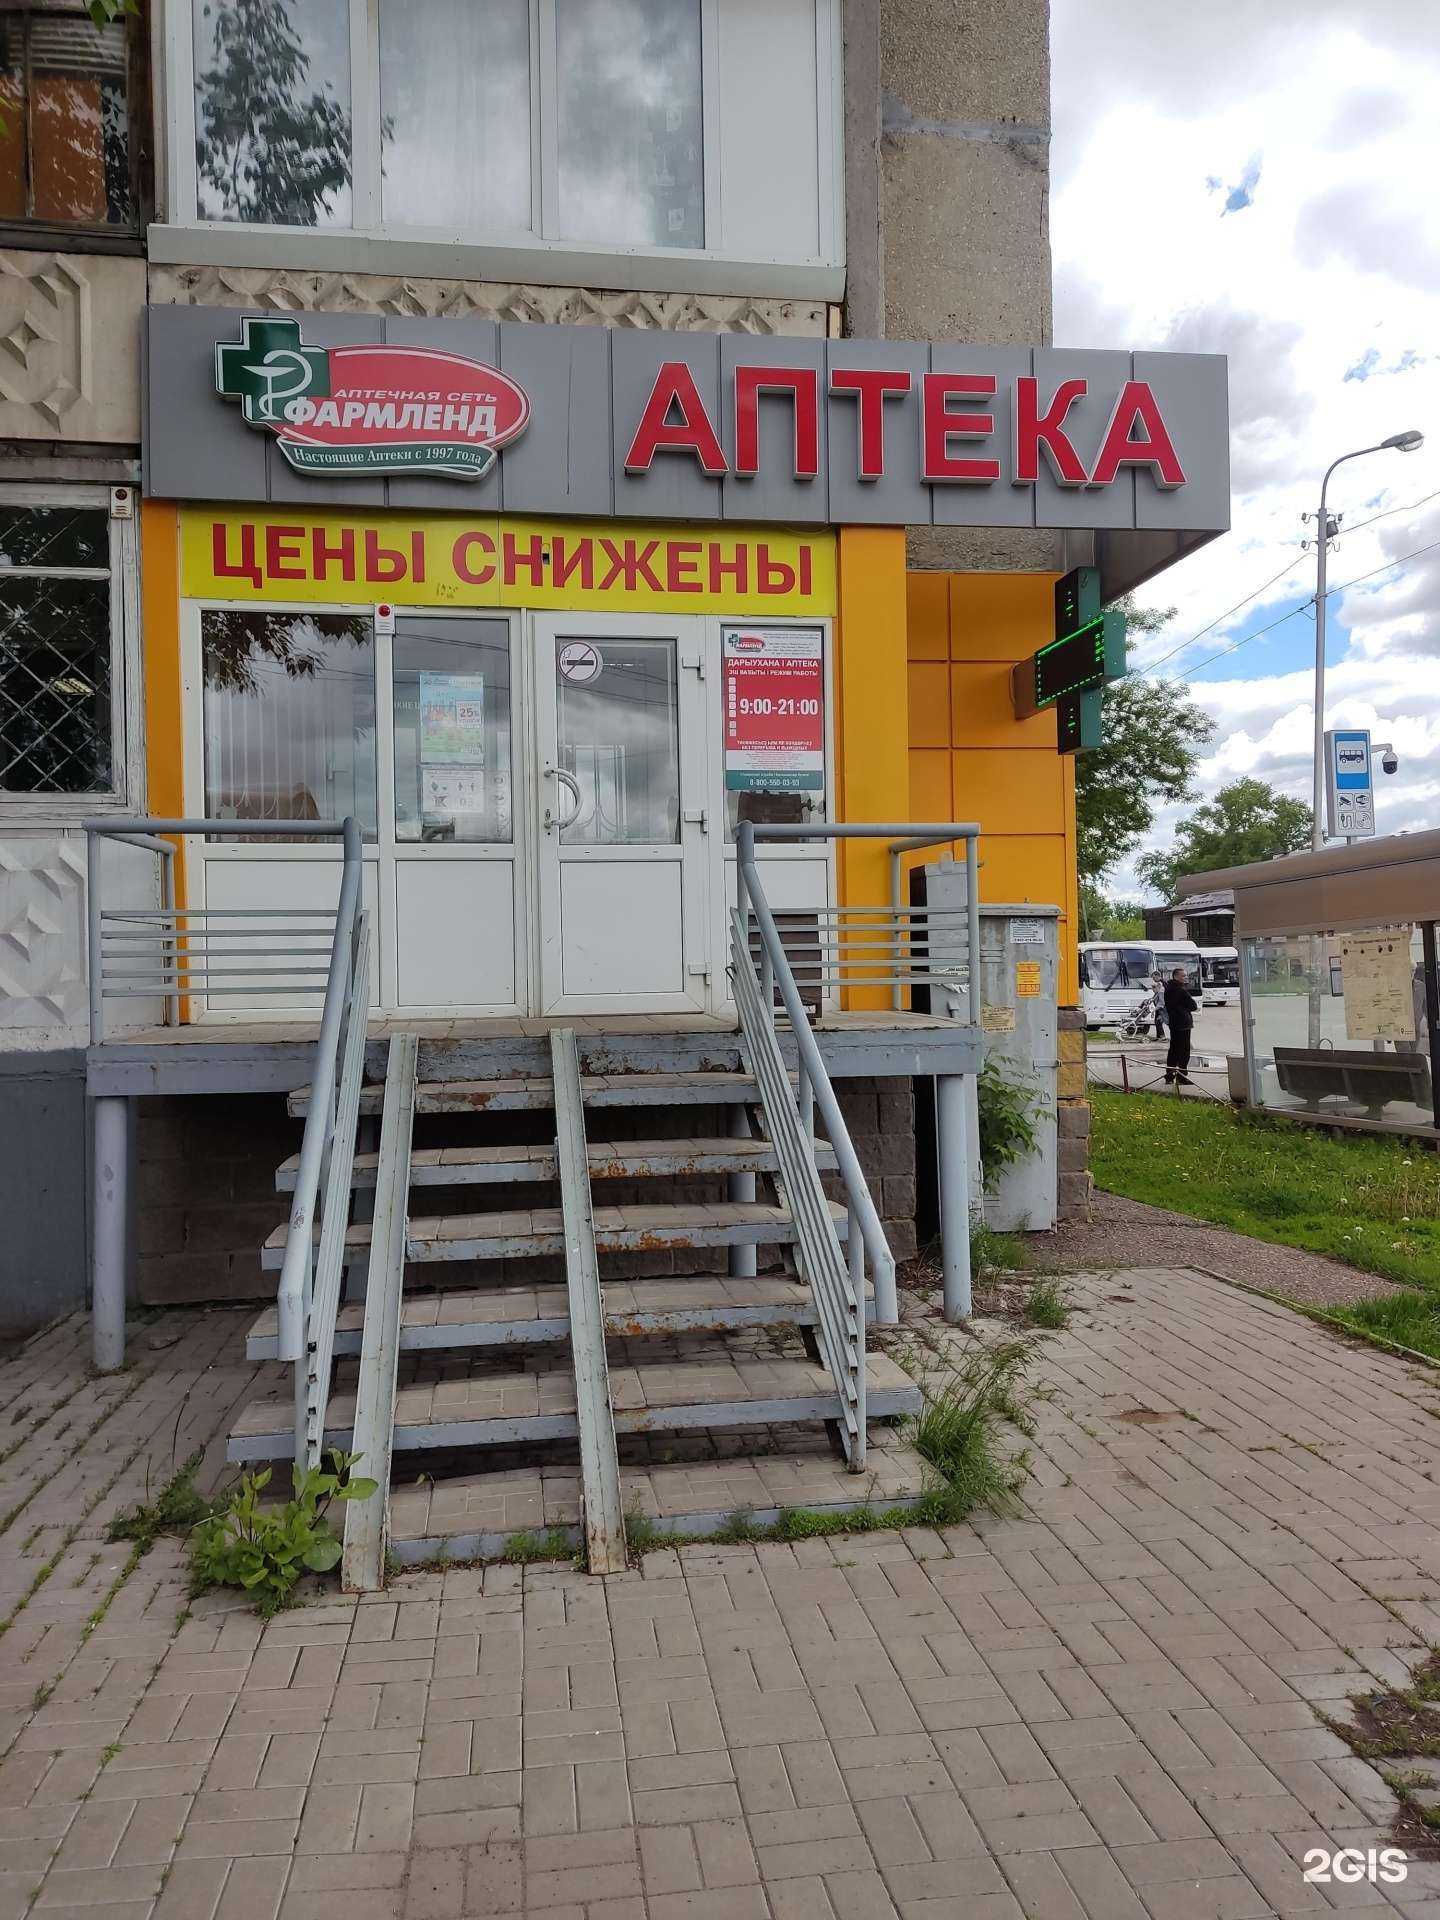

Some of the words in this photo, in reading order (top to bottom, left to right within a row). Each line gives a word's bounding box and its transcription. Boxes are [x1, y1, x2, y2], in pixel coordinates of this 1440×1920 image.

[334, 389, 441, 402] АПТЕЧНАЯ
[446, 391, 498, 403] СЕТЬ
[284, 395, 498, 438] ФАРМЛЕНД
[624, 360, 1188, 490] АПТЕКА
[293, 448, 365, 464] Настоящие
[367, 449, 412, 463] Аптеки
[414, 451, 423, 460] с
[425, 447, 454, 460] 1997
[455, 450, 483, 465] года
[212, 522, 426, 589] ЦЕНЫ
[451, 530, 813, 597] СНИЖЕНЫ
[786, 659, 819, 668] АПТЕКА
[739, 698, 819, 716] 9:00-21:00
